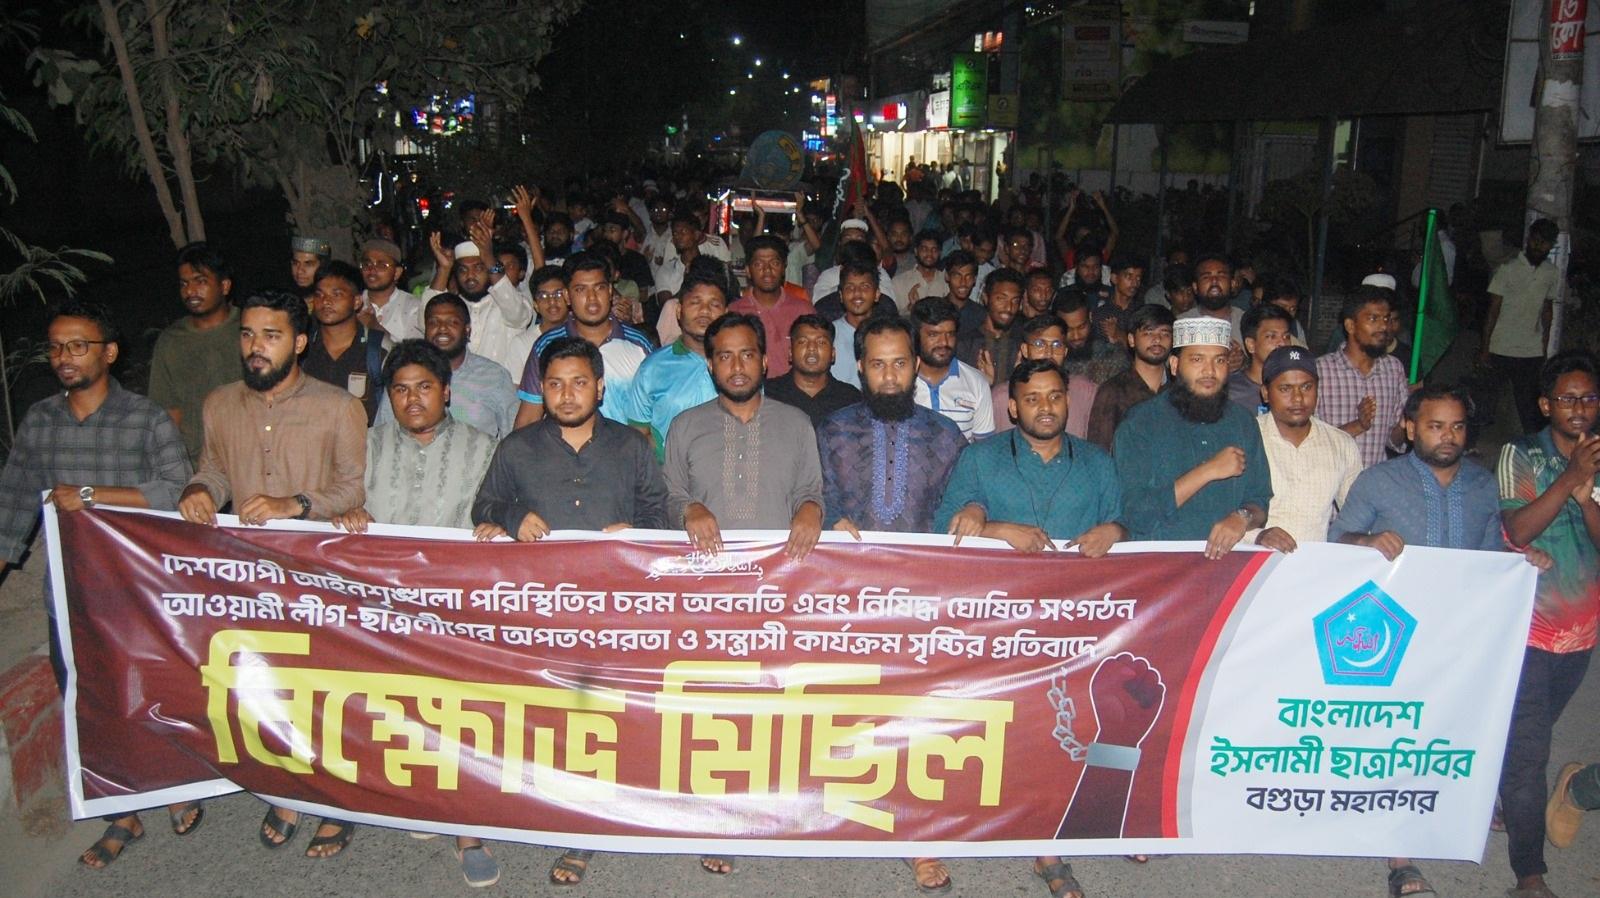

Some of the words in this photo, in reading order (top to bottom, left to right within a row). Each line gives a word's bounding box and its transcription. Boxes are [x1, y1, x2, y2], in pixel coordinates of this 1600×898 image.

[161, 553, 286, 584] দেশব্যাপী
[288, 569, 464, 610] আইনশৃঙ্খলা
[469, 581, 607, 617] পরিস্থিতির
[612, 592, 676, 615] চরম
[682, 585, 787, 613] অবনতি
[792, 593, 851, 616] এবং
[857, 586, 941, 621] নিষিদ্ধ
[947, 590, 1034, 620] ঘোষিত
[1039, 592, 1137, 621] সংগঠন
[161, 592, 285, 622] আওয়ামী
[288, 593, 496, 642] লীগ-ছাত্রলীগের
[500, 624, 671, 653] অপতৎপরতা
[677, 629, 699, 650] ও
[705, 620, 788, 657] সন্ত্রাসী
[793, 623, 903, 654] কার্যক্রম
[908, 626, 986, 664] সৃষ্টির
[991, 628, 1098, 658] প্রতিবাদে
[200, 629, 626, 799] বিক্ষোভ
[655, 660, 1014, 833] মিছিল
[1277, 698, 1424, 730] বাংলাদেশ
[1210, 735, 1324, 777] ইসলামী
[1330, 737, 1476, 780] ছাত্রশিবির
[1246, 787, 1325, 817] বগুড়া
[1330, 789, 1438, 815] মহানগর
